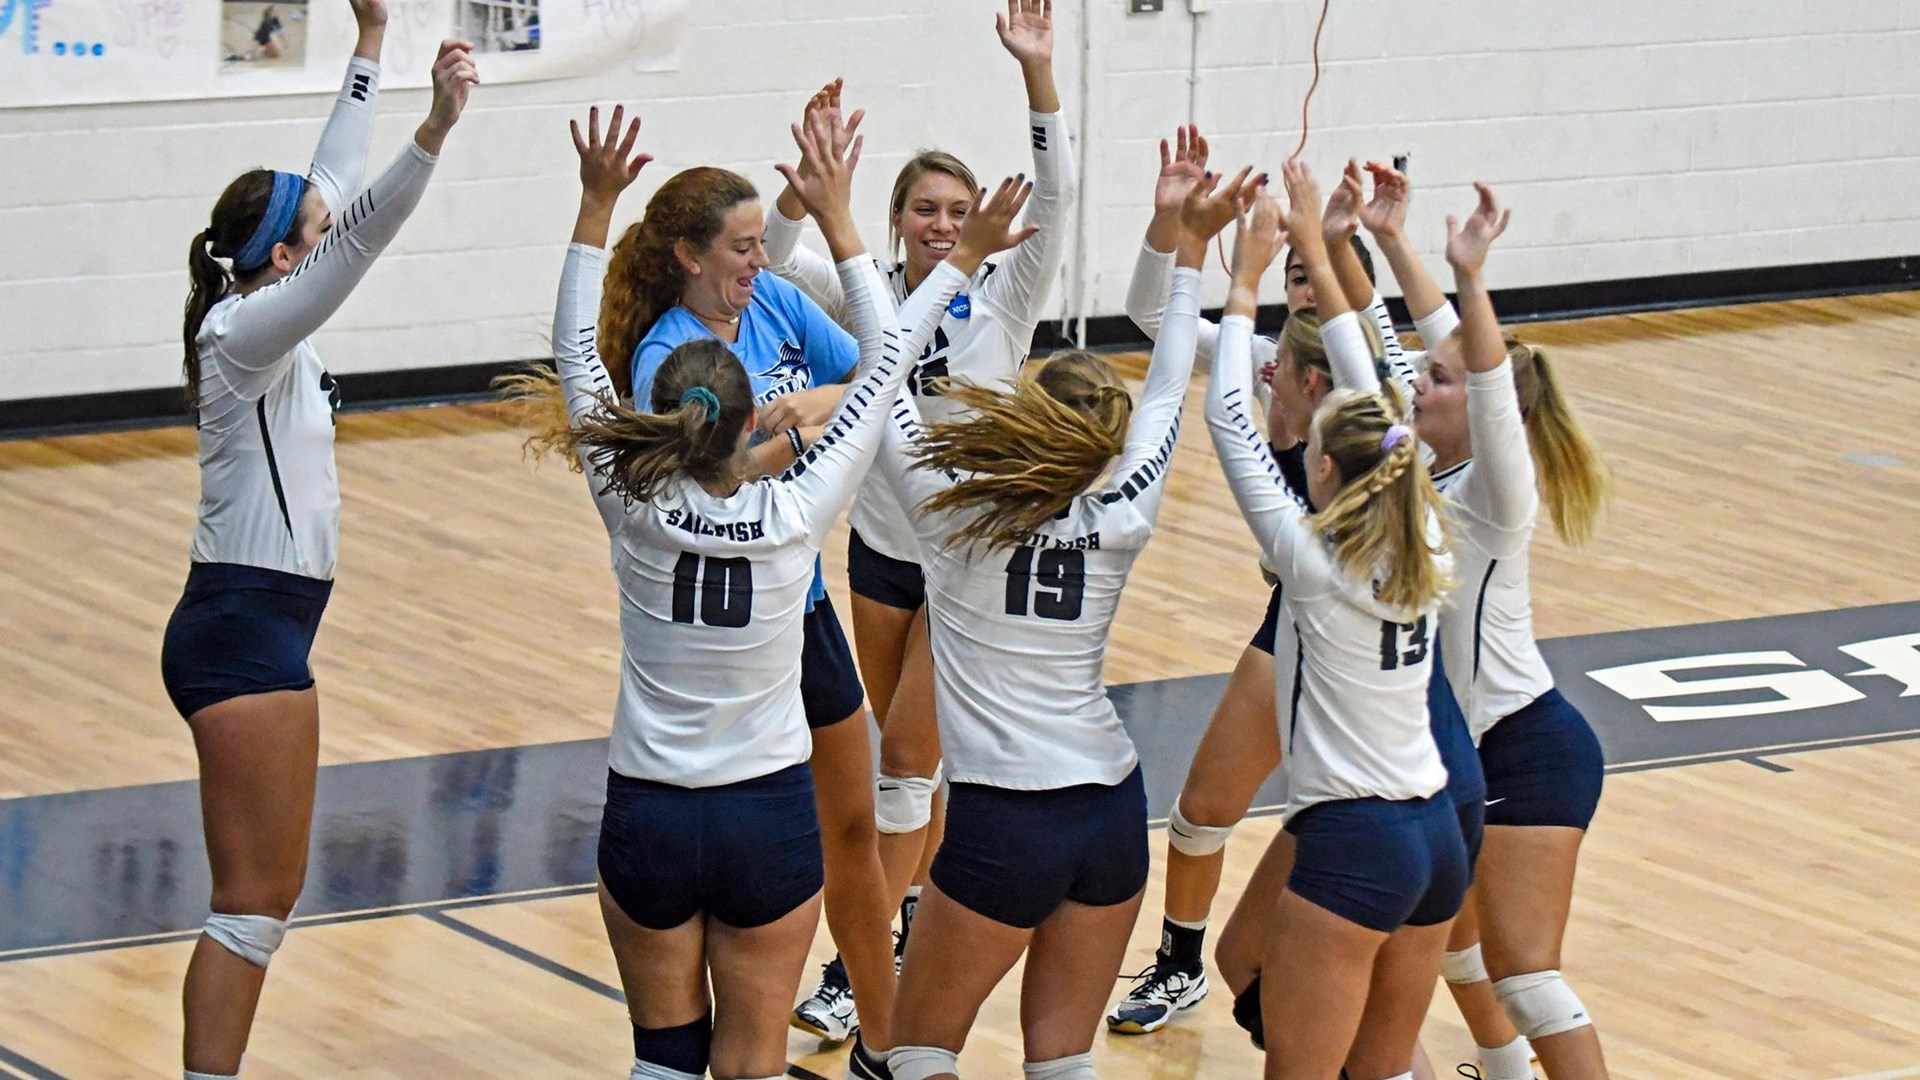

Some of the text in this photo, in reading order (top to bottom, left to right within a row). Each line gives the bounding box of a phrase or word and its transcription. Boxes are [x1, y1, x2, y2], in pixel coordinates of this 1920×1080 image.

[666, 509, 764, 542] SAILFISH
[672, 551, 753, 628] 10
[1005, 545, 1085, 621] 19
[1380, 614, 1428, 670] 13
